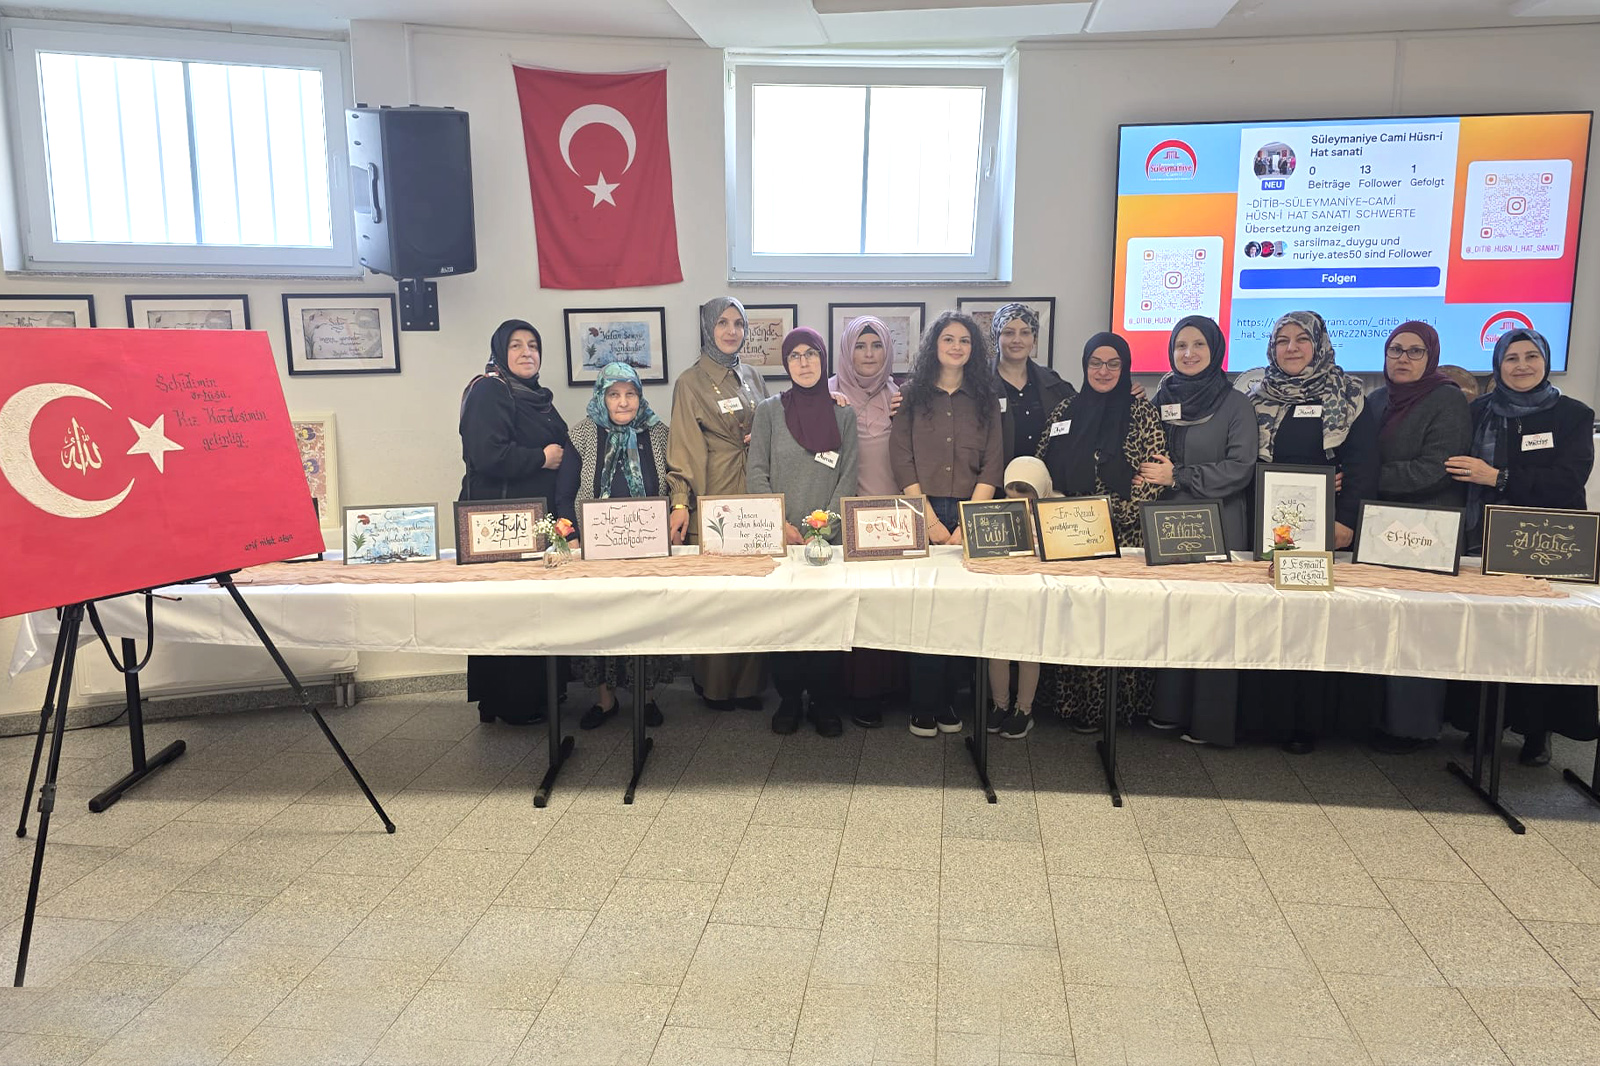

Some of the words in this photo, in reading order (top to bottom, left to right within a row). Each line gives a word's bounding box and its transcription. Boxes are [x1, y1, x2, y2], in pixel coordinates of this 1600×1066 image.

[1311, 134, 1377, 145] Süleymaniye
[1380, 133, 1406, 142] Cami
[1409, 131, 1443, 141] Hüsn-i
[1310, 149, 1328, 157] Hat
[1331, 147, 1363, 156] sanati
[1309, 167, 1316, 175] 0
[1360, 165, 1371, 174] 13
[1411, 164, 1416, 173] 1
[1264, 181, 1283, 189] NEU
[1308, 179, 1350, 189] Beiträge
[1359, 178, 1401, 187] Follower
[1410, 177, 1445, 188] Gefolgt
[1287, 211, 1308, 219] HAT
[1311, 210, 1350, 219] SANATI
[1356, 208, 1416, 218] SCHWERTE
[1245, 223, 1311, 234] Übersetzung
[1313, 224, 1360, 234] anzeigen
[1293, 238, 1378, 248] sarsilmaz_duygu
[1380, 236, 1400, 246] und
[1293, 250, 1362, 261] nuriye.ates50
[1364, 249, 1386, 259] sind
[1388, 248, 1432, 258] Follower
[1321, 273, 1357, 284] Folgen
